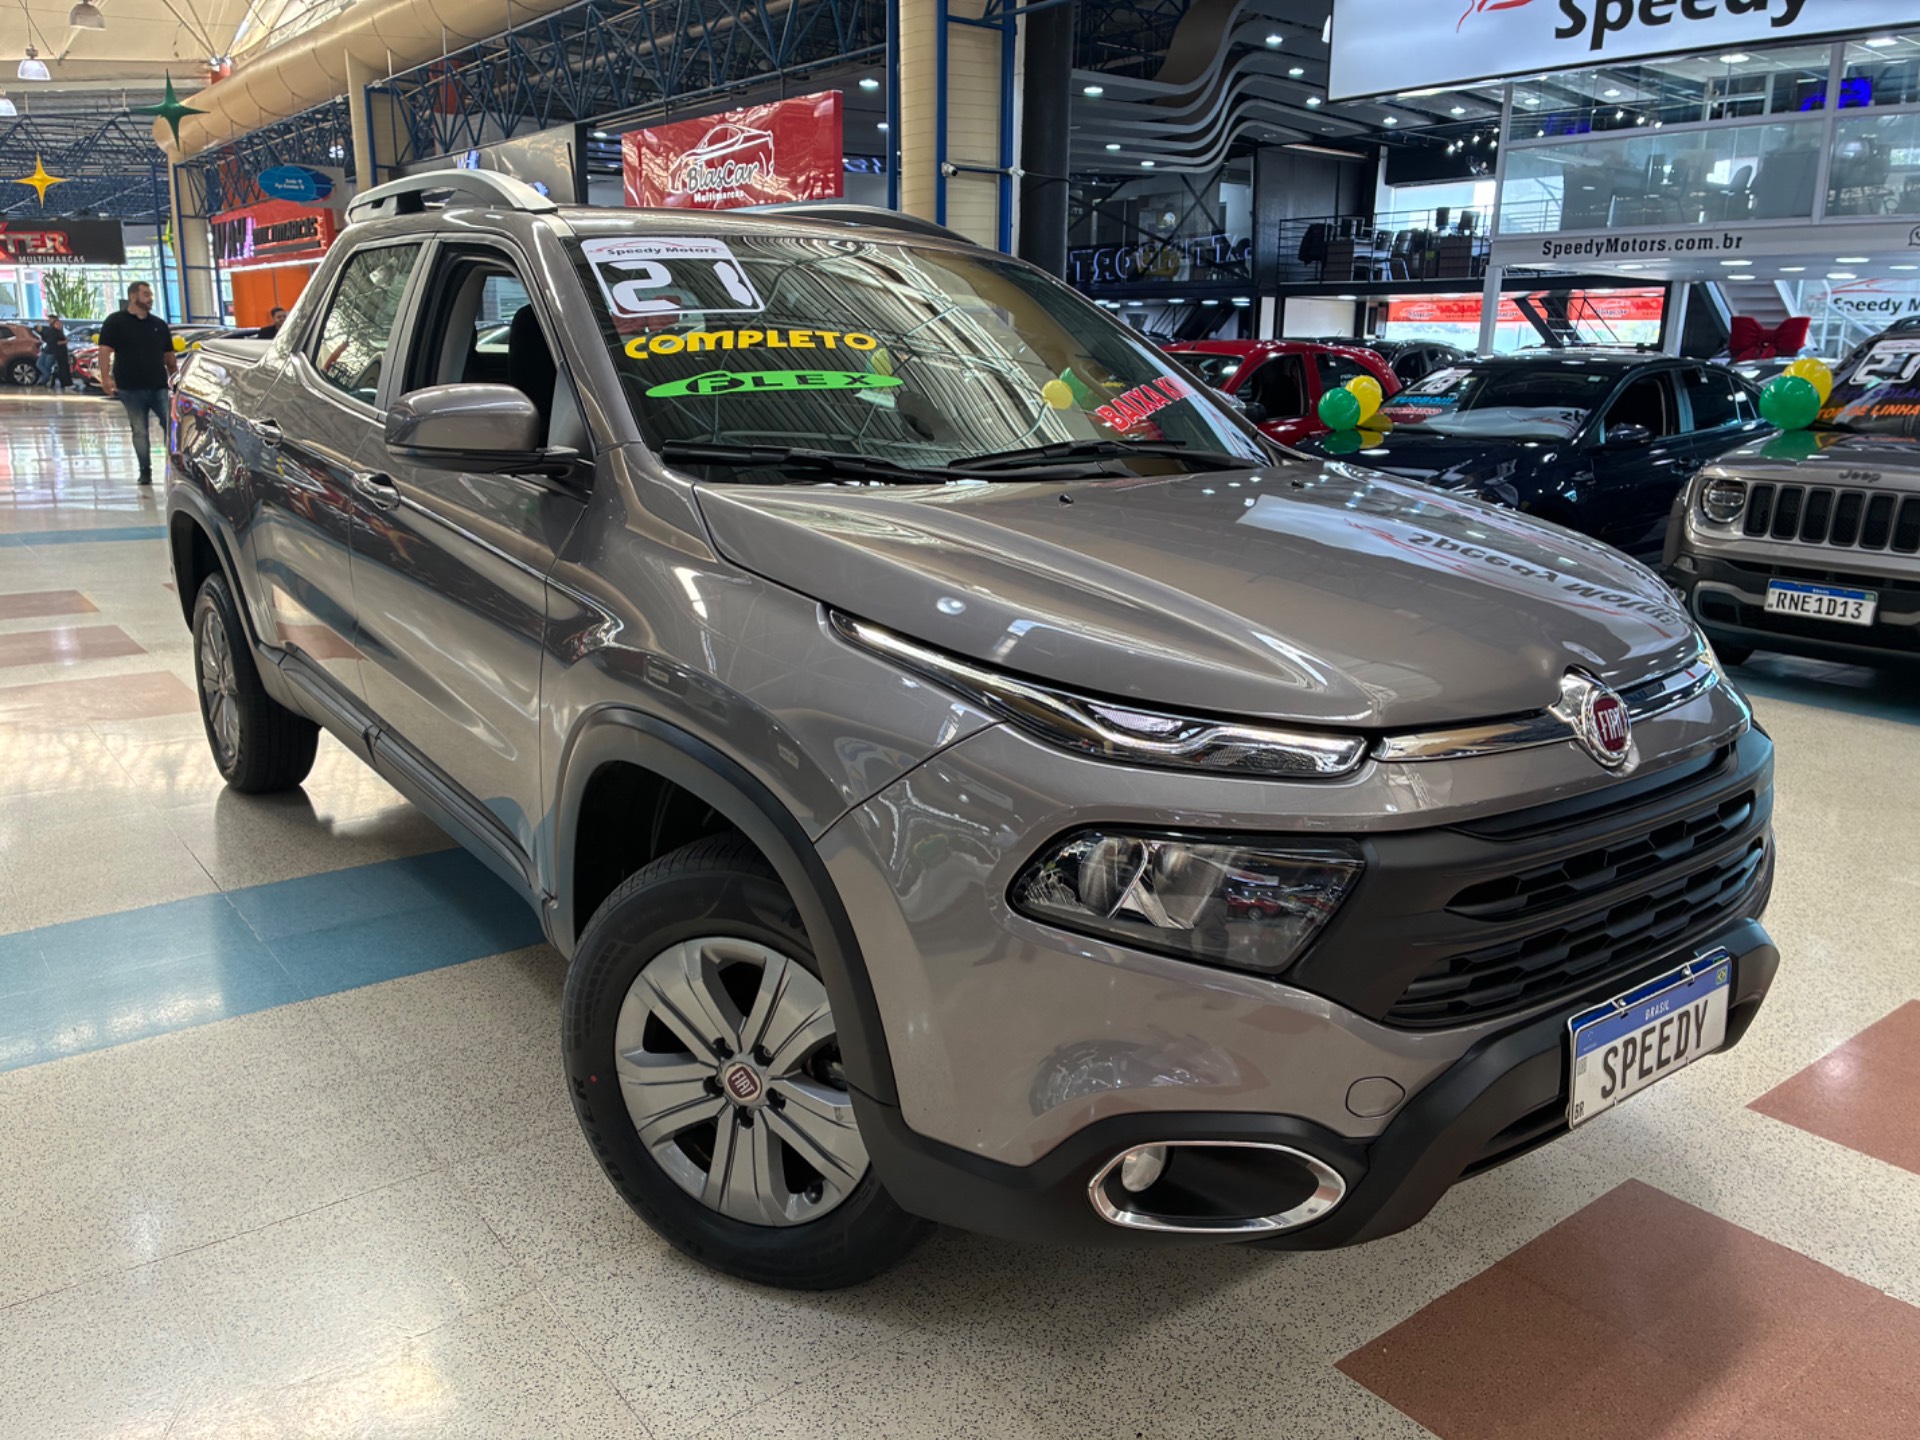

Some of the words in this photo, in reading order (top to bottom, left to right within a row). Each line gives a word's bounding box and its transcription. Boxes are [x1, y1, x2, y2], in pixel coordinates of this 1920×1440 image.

[1555, 0, 1804, 51] Spe
[686, 160, 759, 194] BlasCar
[693, 189, 744, 203] Multimarcas
[607, 246, 662, 256] Speedy
[665, 246, 718, 255] Motors
[1542, 233, 1744, 259] SpeedyMotors.com.br
[18, 255, 86, 264] MULTIMARCAS
[624, 330, 878, 360] COMPLETO
[690, 371, 871, 394] FLEX
[1095, 384, 1171, 432] BAIXA
[1870, 403, 1920, 416] LINHA
[1839, 470, 1881, 483] Jeep
[1775, 592, 1864, 619] RNE1D13
[1598, 706, 1625, 741] FIAT
[1645, 1000, 1670, 1020] BRASIL
[1601, 999, 1708, 1099] SPEEDY
[731, 1070, 755, 1095] FIAT
[1574, 1101, 1584, 1120] BR
